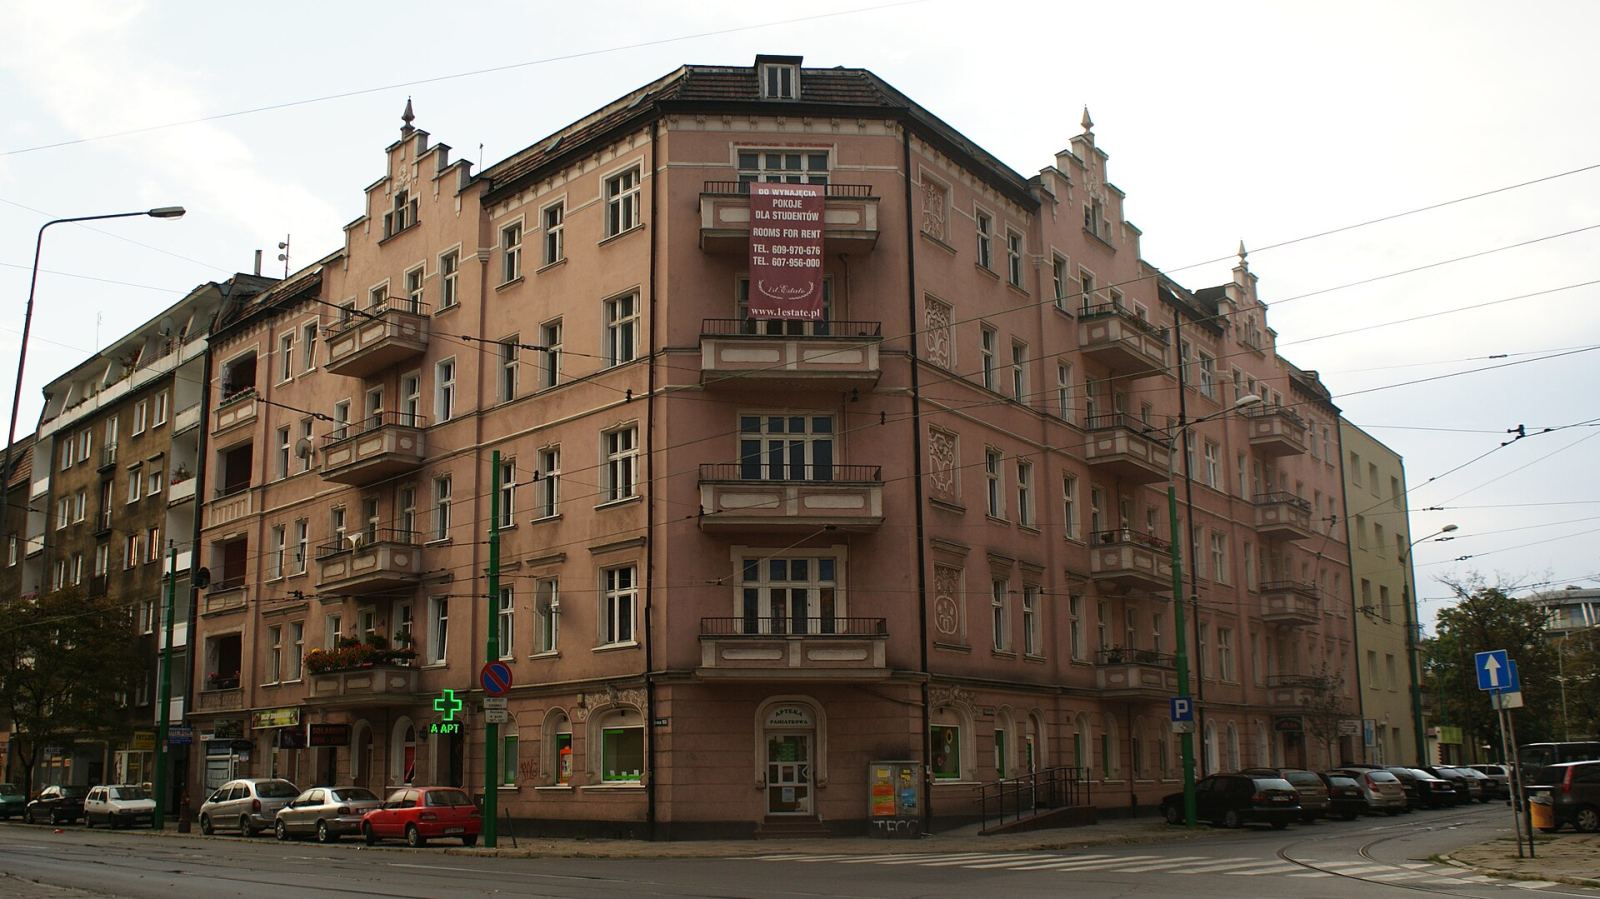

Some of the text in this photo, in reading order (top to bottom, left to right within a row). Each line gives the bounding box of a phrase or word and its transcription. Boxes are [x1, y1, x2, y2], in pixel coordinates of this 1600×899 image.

[772, 189, 816, 198] WYNAJĘCIA
[772, 199, 803, 208] POKOJE
[755, 210, 819, 221] DLA STUDENTÓW
[753, 228, 821, 239] ROOMS FOR RENT
[753, 244, 820, 255] TEL. 609-970-676
[753, 256, 820, 268] TEL. 607-956-000
[751, 307, 820, 319] www.1estate.pl
[776, 709, 802, 717] APTEKA
[1175, 700, 1188, 718] P
[440, 724, 460, 734] APT
